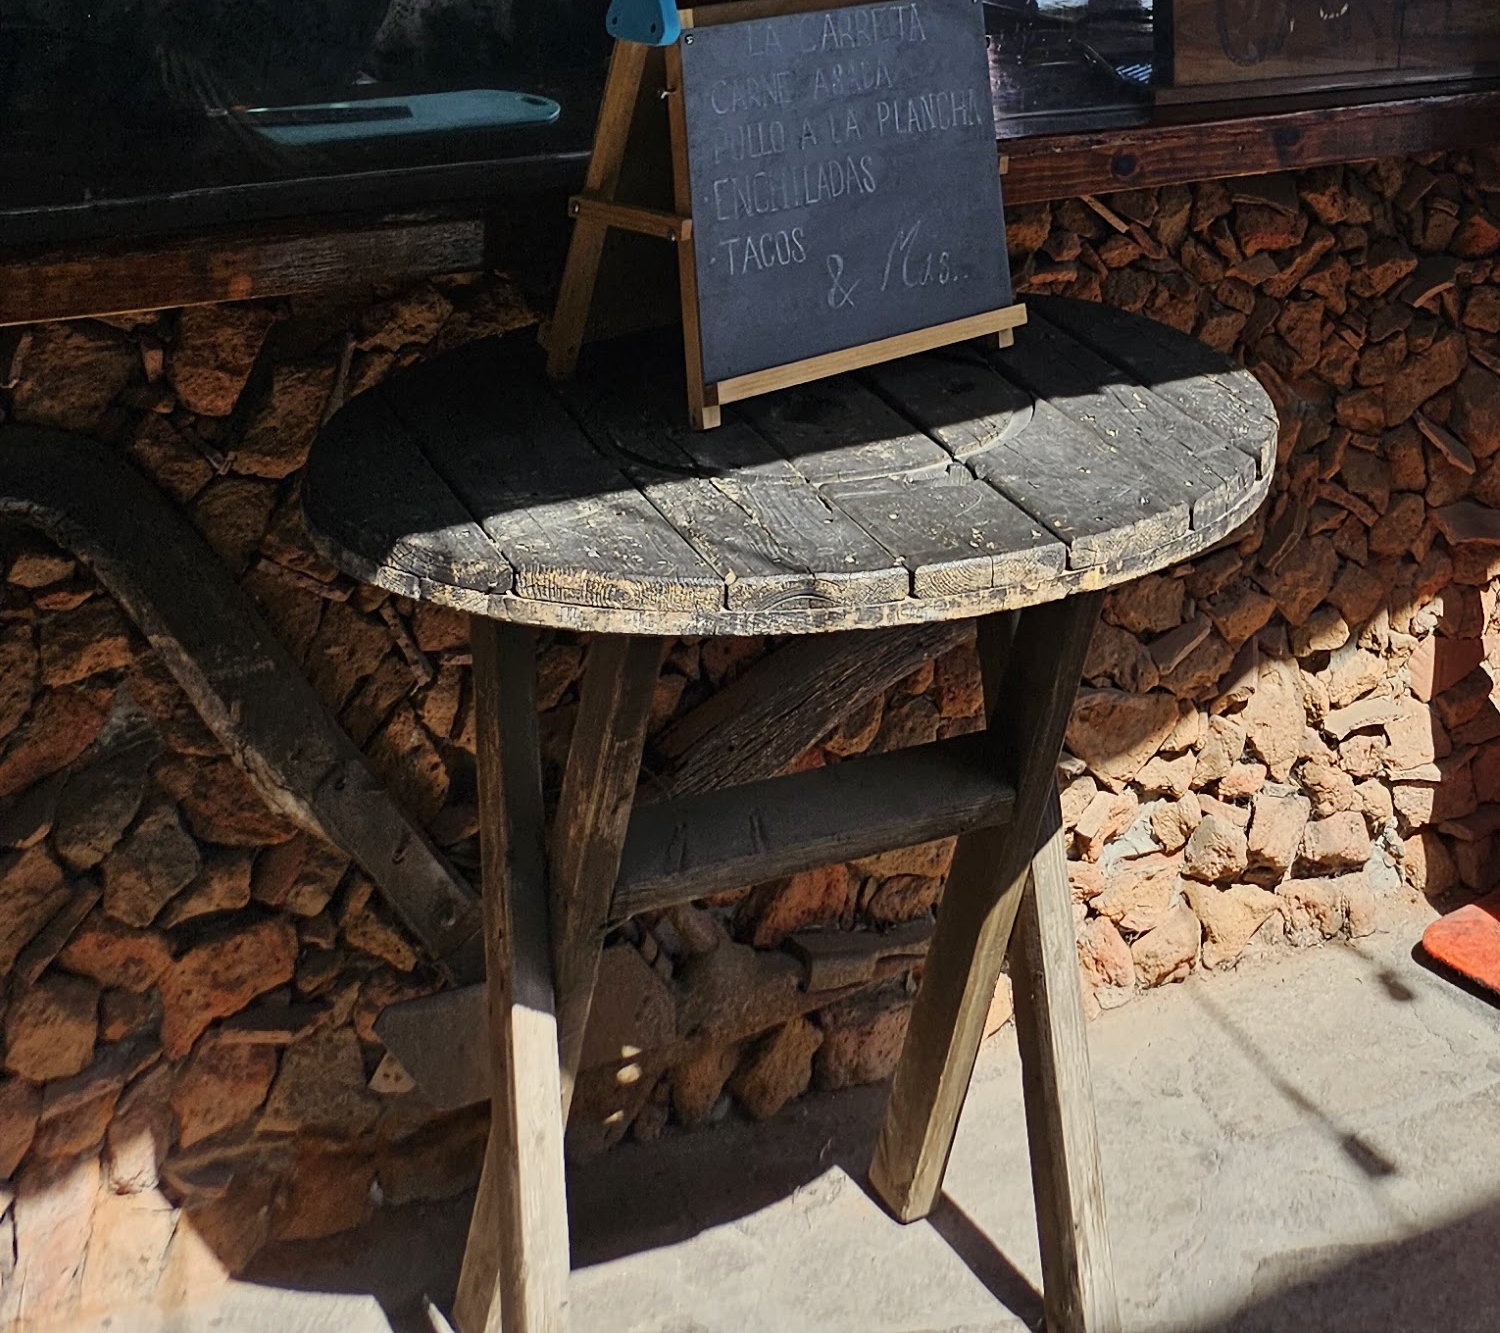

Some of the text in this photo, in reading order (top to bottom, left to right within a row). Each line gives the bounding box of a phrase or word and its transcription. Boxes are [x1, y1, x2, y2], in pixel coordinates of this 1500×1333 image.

[748, 3, 927, 56] LA CARRETA
[711, 71, 794, 115] CARNE
[800, 117, 818, 150] A
[830, 108, 862, 144] LA
[876, 88, 983, 137] PLANCHA
[712, 154, 877, 221] ENCHILADAS
[718, 226, 807, 276] TACOS
[826, 253, 863, 309] &
